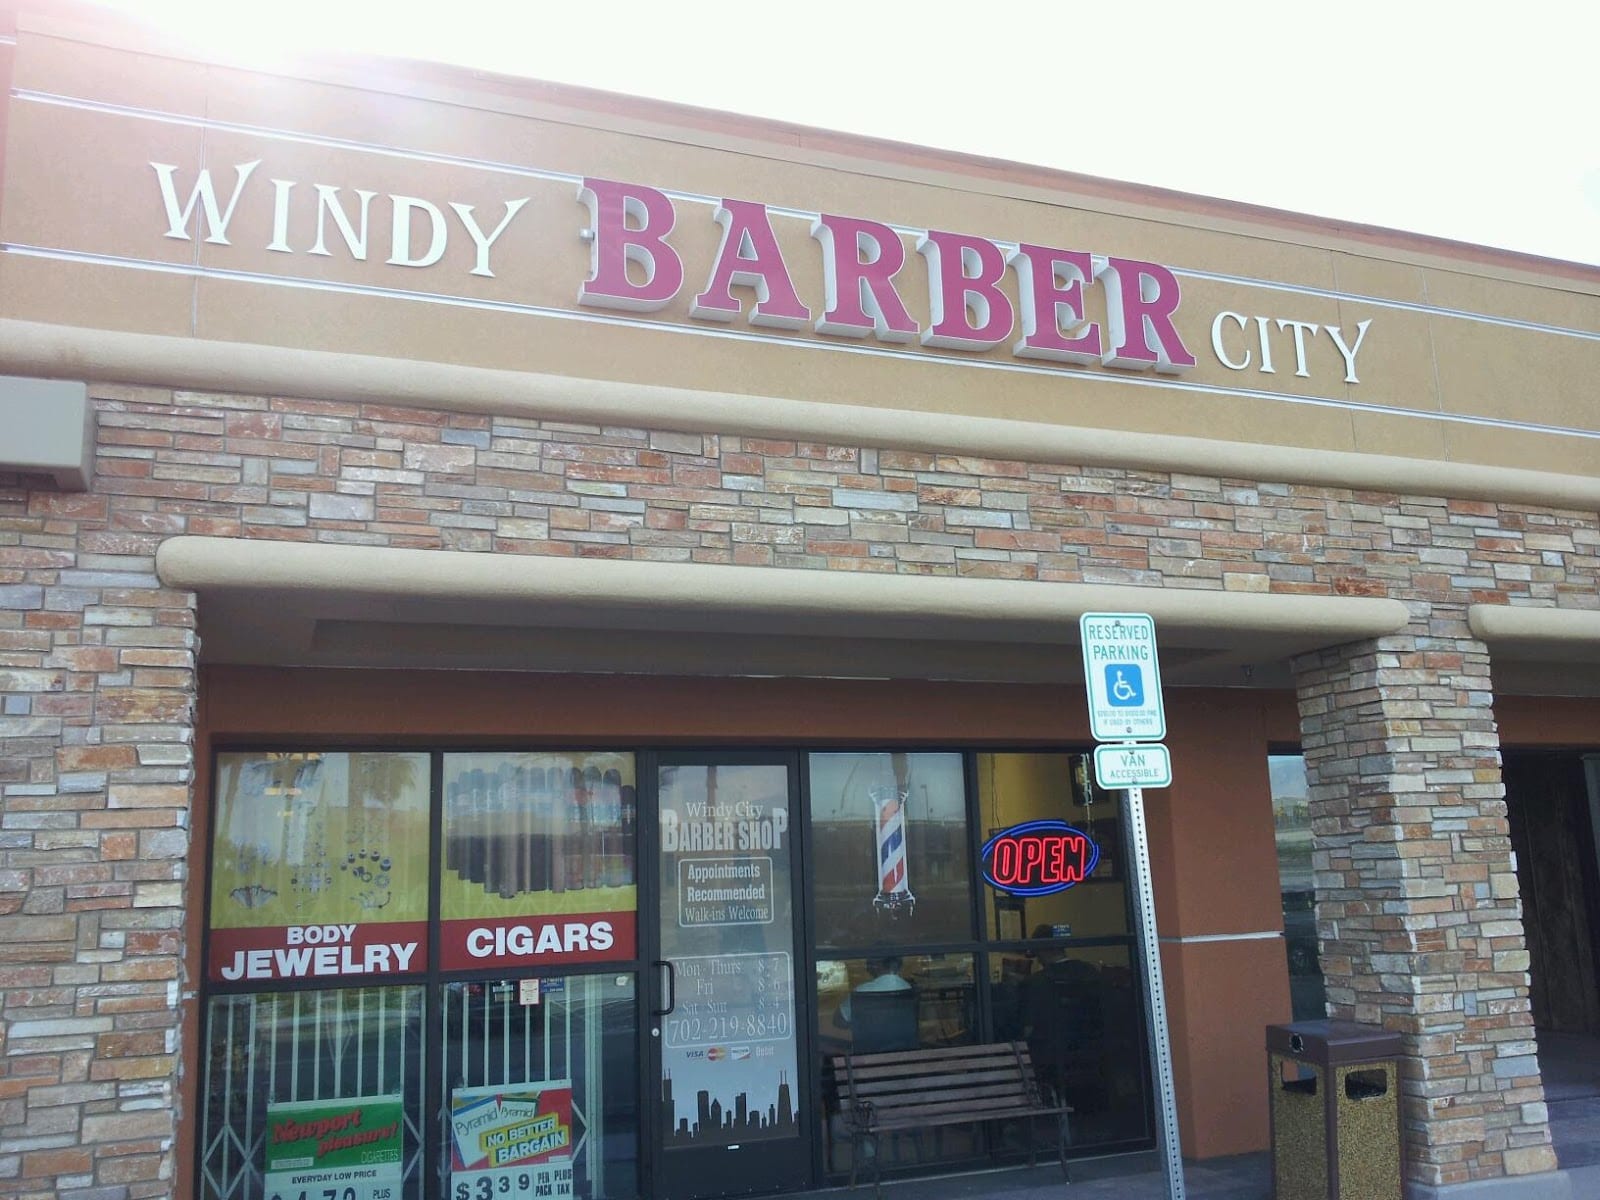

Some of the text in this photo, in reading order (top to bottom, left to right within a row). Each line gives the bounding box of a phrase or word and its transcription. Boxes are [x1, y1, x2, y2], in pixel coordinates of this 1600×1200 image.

[149, 159, 1373, 384] WINDY BARBER CITY
[1089, 625, 1149, 640] RESERVED
[1093, 645, 1149, 660] PARKING
[1120, 755, 1146, 767] VAN
[1110, 768, 1159, 779] ACCESSIBLE
[686, 801, 763, 820] Windy City
[662, 808, 788, 852] BARBER SHOP
[993, 836, 1086, 884] OPEN
[688, 863, 760, 883] Appointments
[687, 884, 765, 902] Recommended
[685, 905, 768, 922] Walk-ins Welcome
[287, 924, 357, 945] BODY
[466, 921, 614, 958] CIGARS
[221, 942, 418, 981] JEWELRY
[697, 979, 713, 995] Fri
[669, 1013, 787, 1042] 702-219-8840
[686, 1050, 704, 1058] VISA
[455, 1107, 499, 1137] Pyramid
[501, 1107, 534, 1119] Pyramid
[271, 1109, 363, 1144] Newport
[487, 1118, 555, 1148] NO BETTER
[498, 1131, 565, 1164] BARGAIN
[292, 1170, 377, 1184] EVERYDAY LOW PRICE
[554, 1169, 573, 1181] PLUS
[373, 1189, 390, 1200] PLUS
[535, 1183, 571, 1197] PACK TAX
